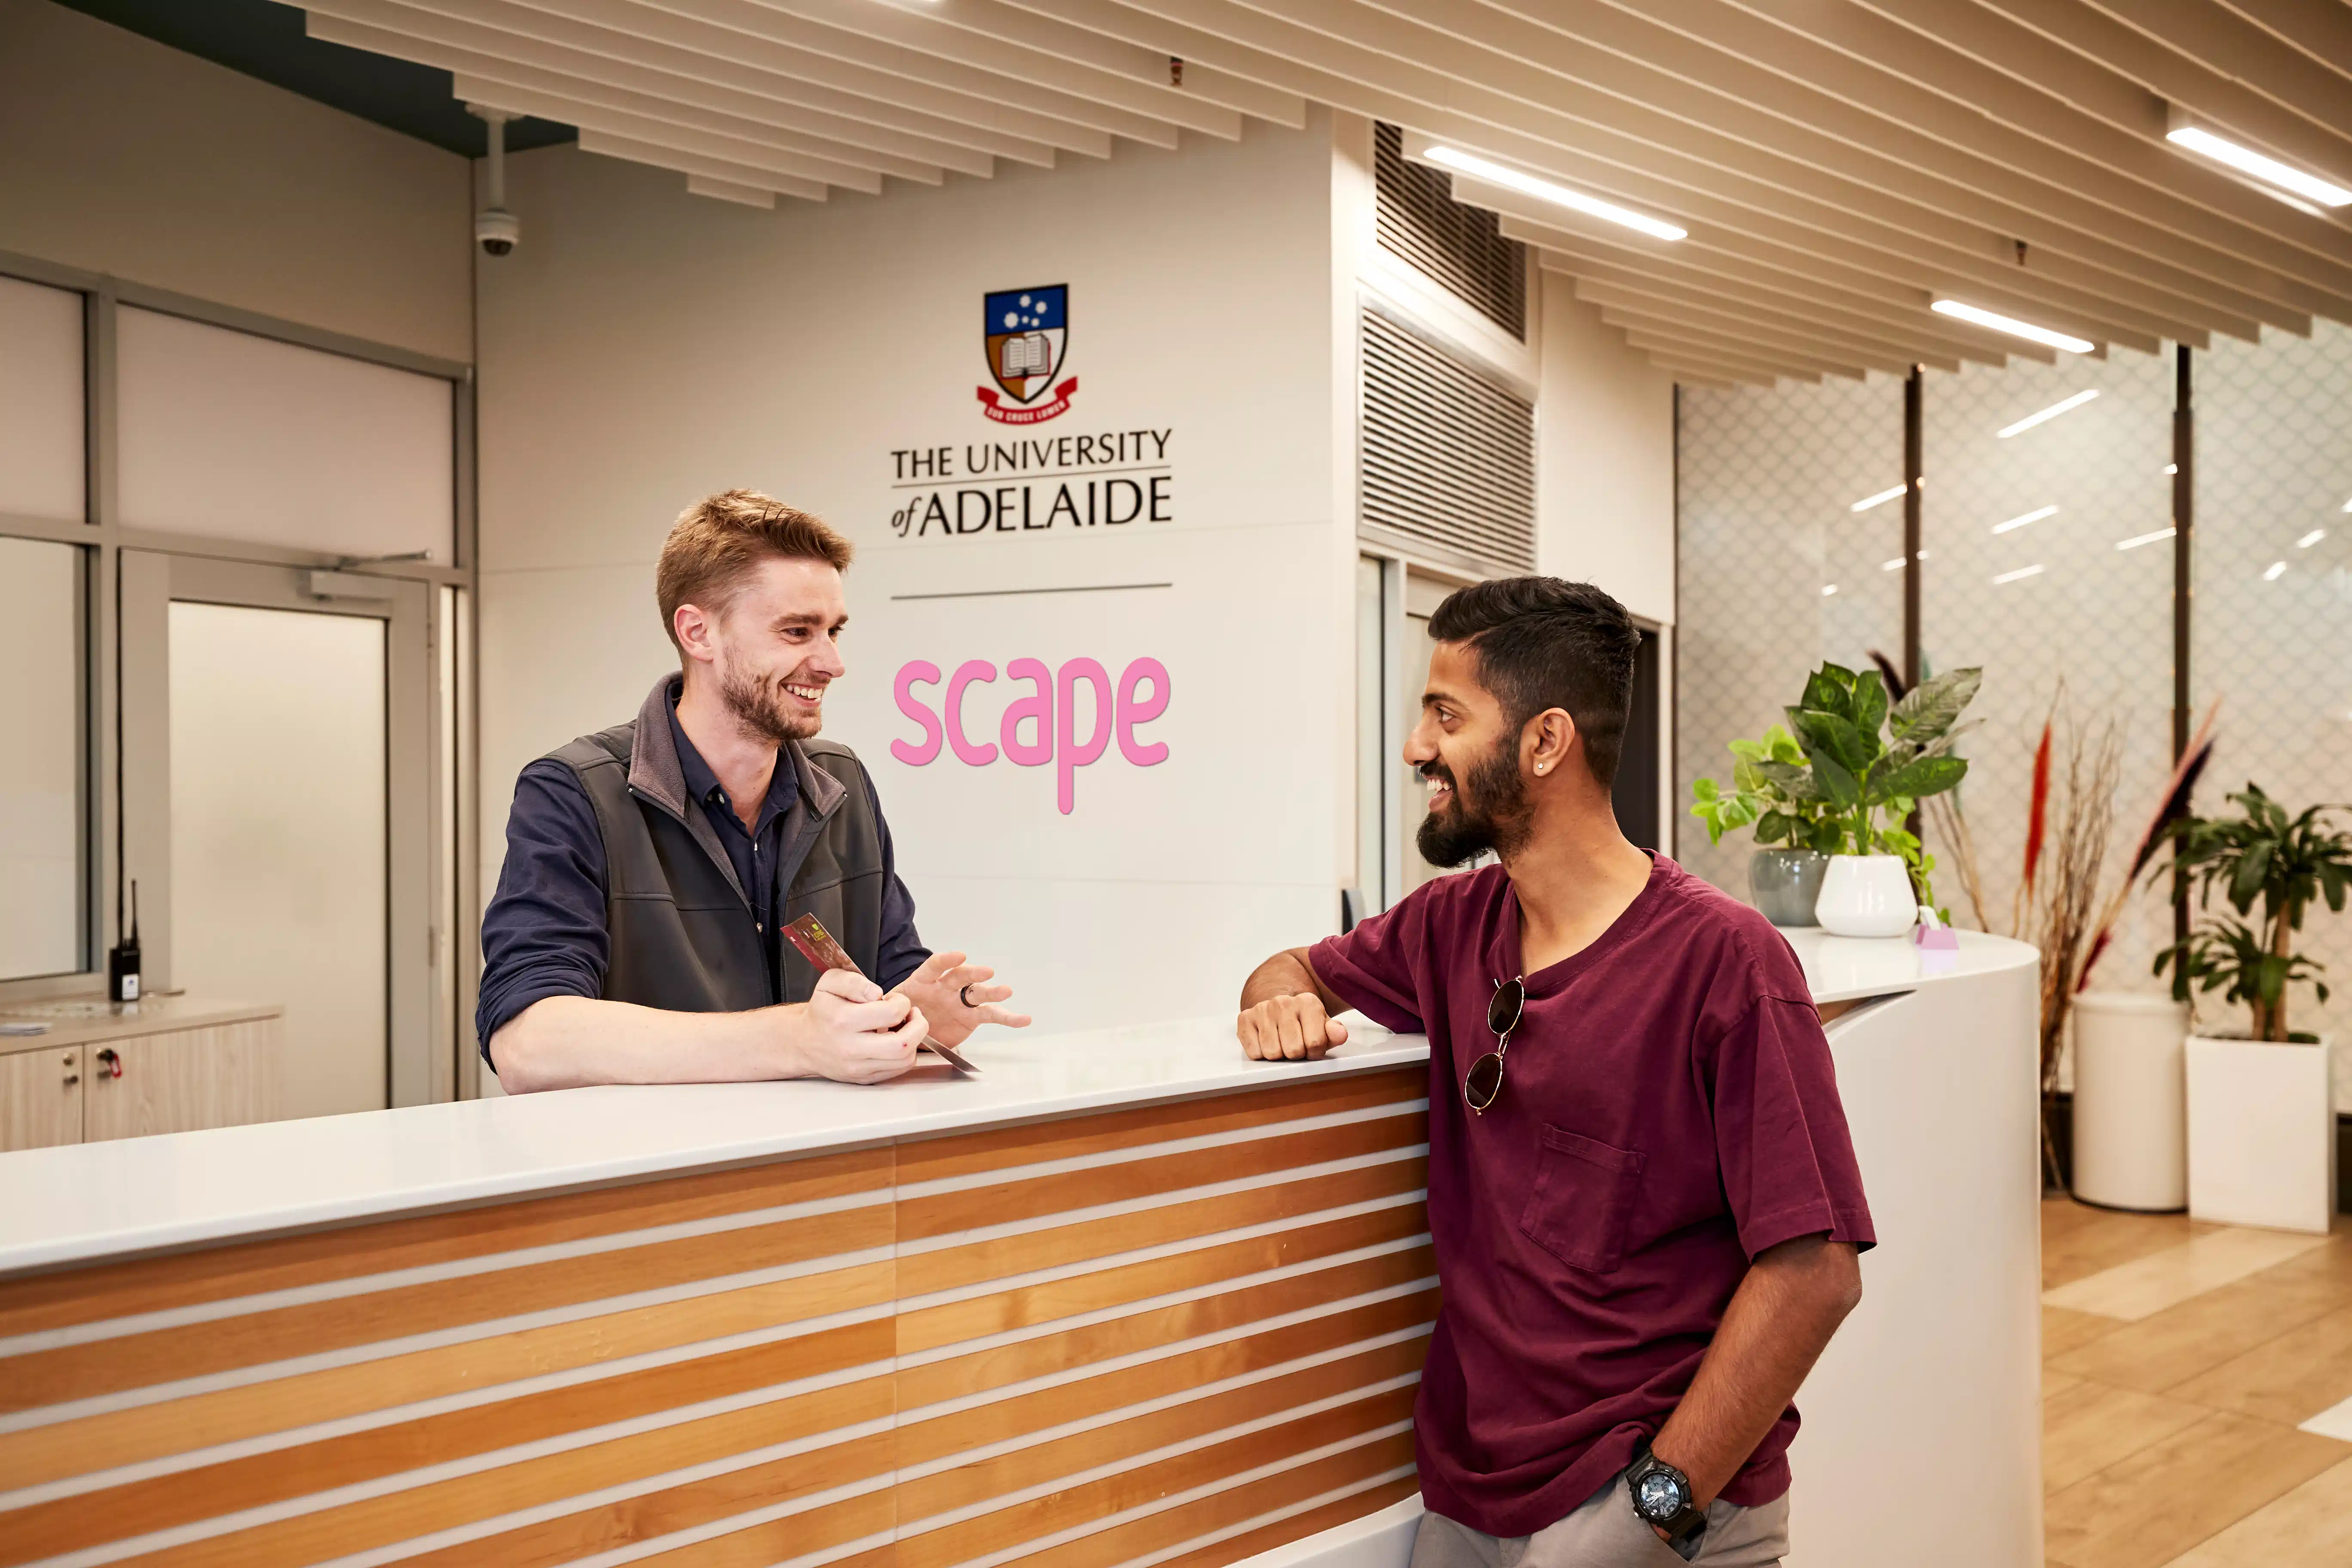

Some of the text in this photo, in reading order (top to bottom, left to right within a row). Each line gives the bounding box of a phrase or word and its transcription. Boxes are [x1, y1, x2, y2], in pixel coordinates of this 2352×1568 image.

[891, 428, 1172, 479] THE UNIVERSITY
[891, 476, 1172, 538] of ADELAIDE
[890, 657, 1171, 815] scape
